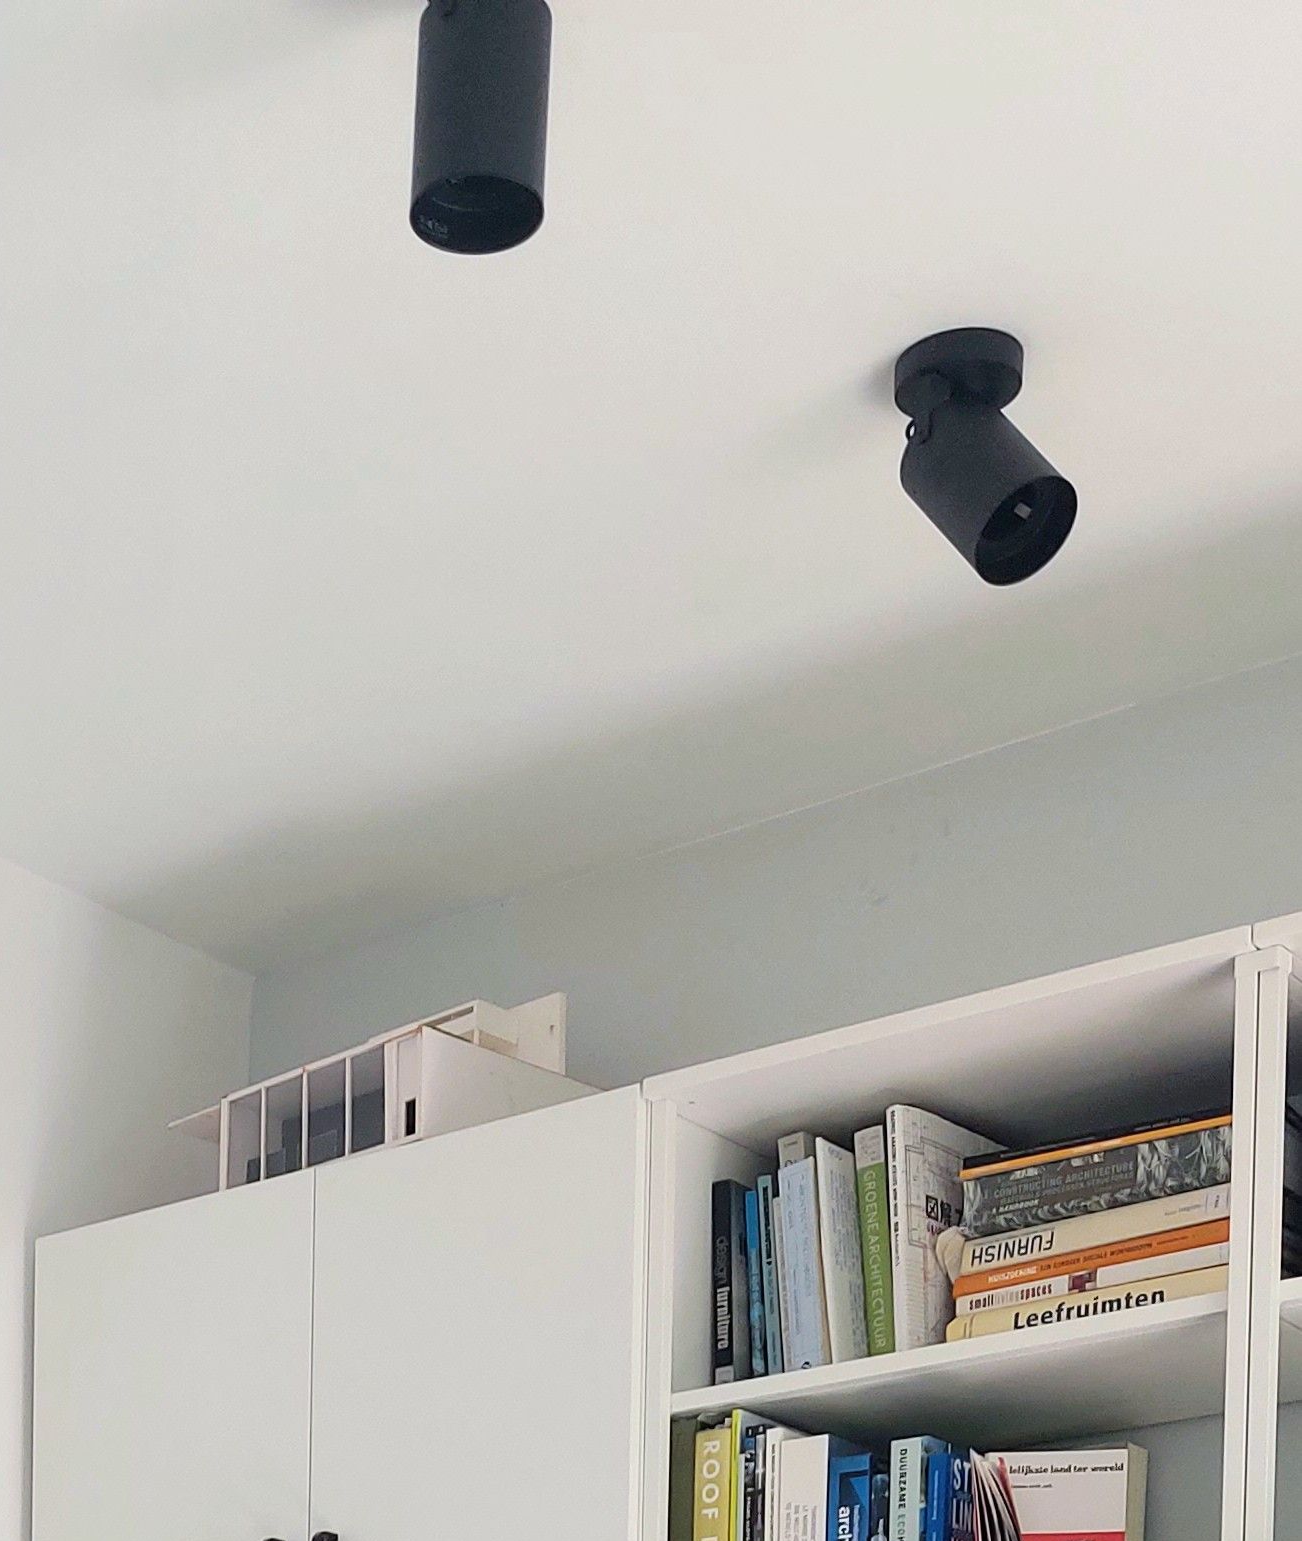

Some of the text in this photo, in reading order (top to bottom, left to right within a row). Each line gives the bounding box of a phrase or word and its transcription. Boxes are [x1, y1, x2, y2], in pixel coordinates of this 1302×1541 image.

[864, 1170, 880, 1232] GROENE
[970, 1231, 1056, 1268] FURNISH
[716, 1287, 730, 1350] furniture
[868, 1234, 886, 1348] ARCHITECTUUR
[1013, 1289, 1165, 1330] Leefruimten
[701, 1439, 720, 1519] ROOF
[898, 1448, 908, 1509] DUURZAME
[1051, 1464, 1072, 1473] land
[1073, 1465, 1087, 1473] ter
[1091, 1463, 1124, 1472] wereld
